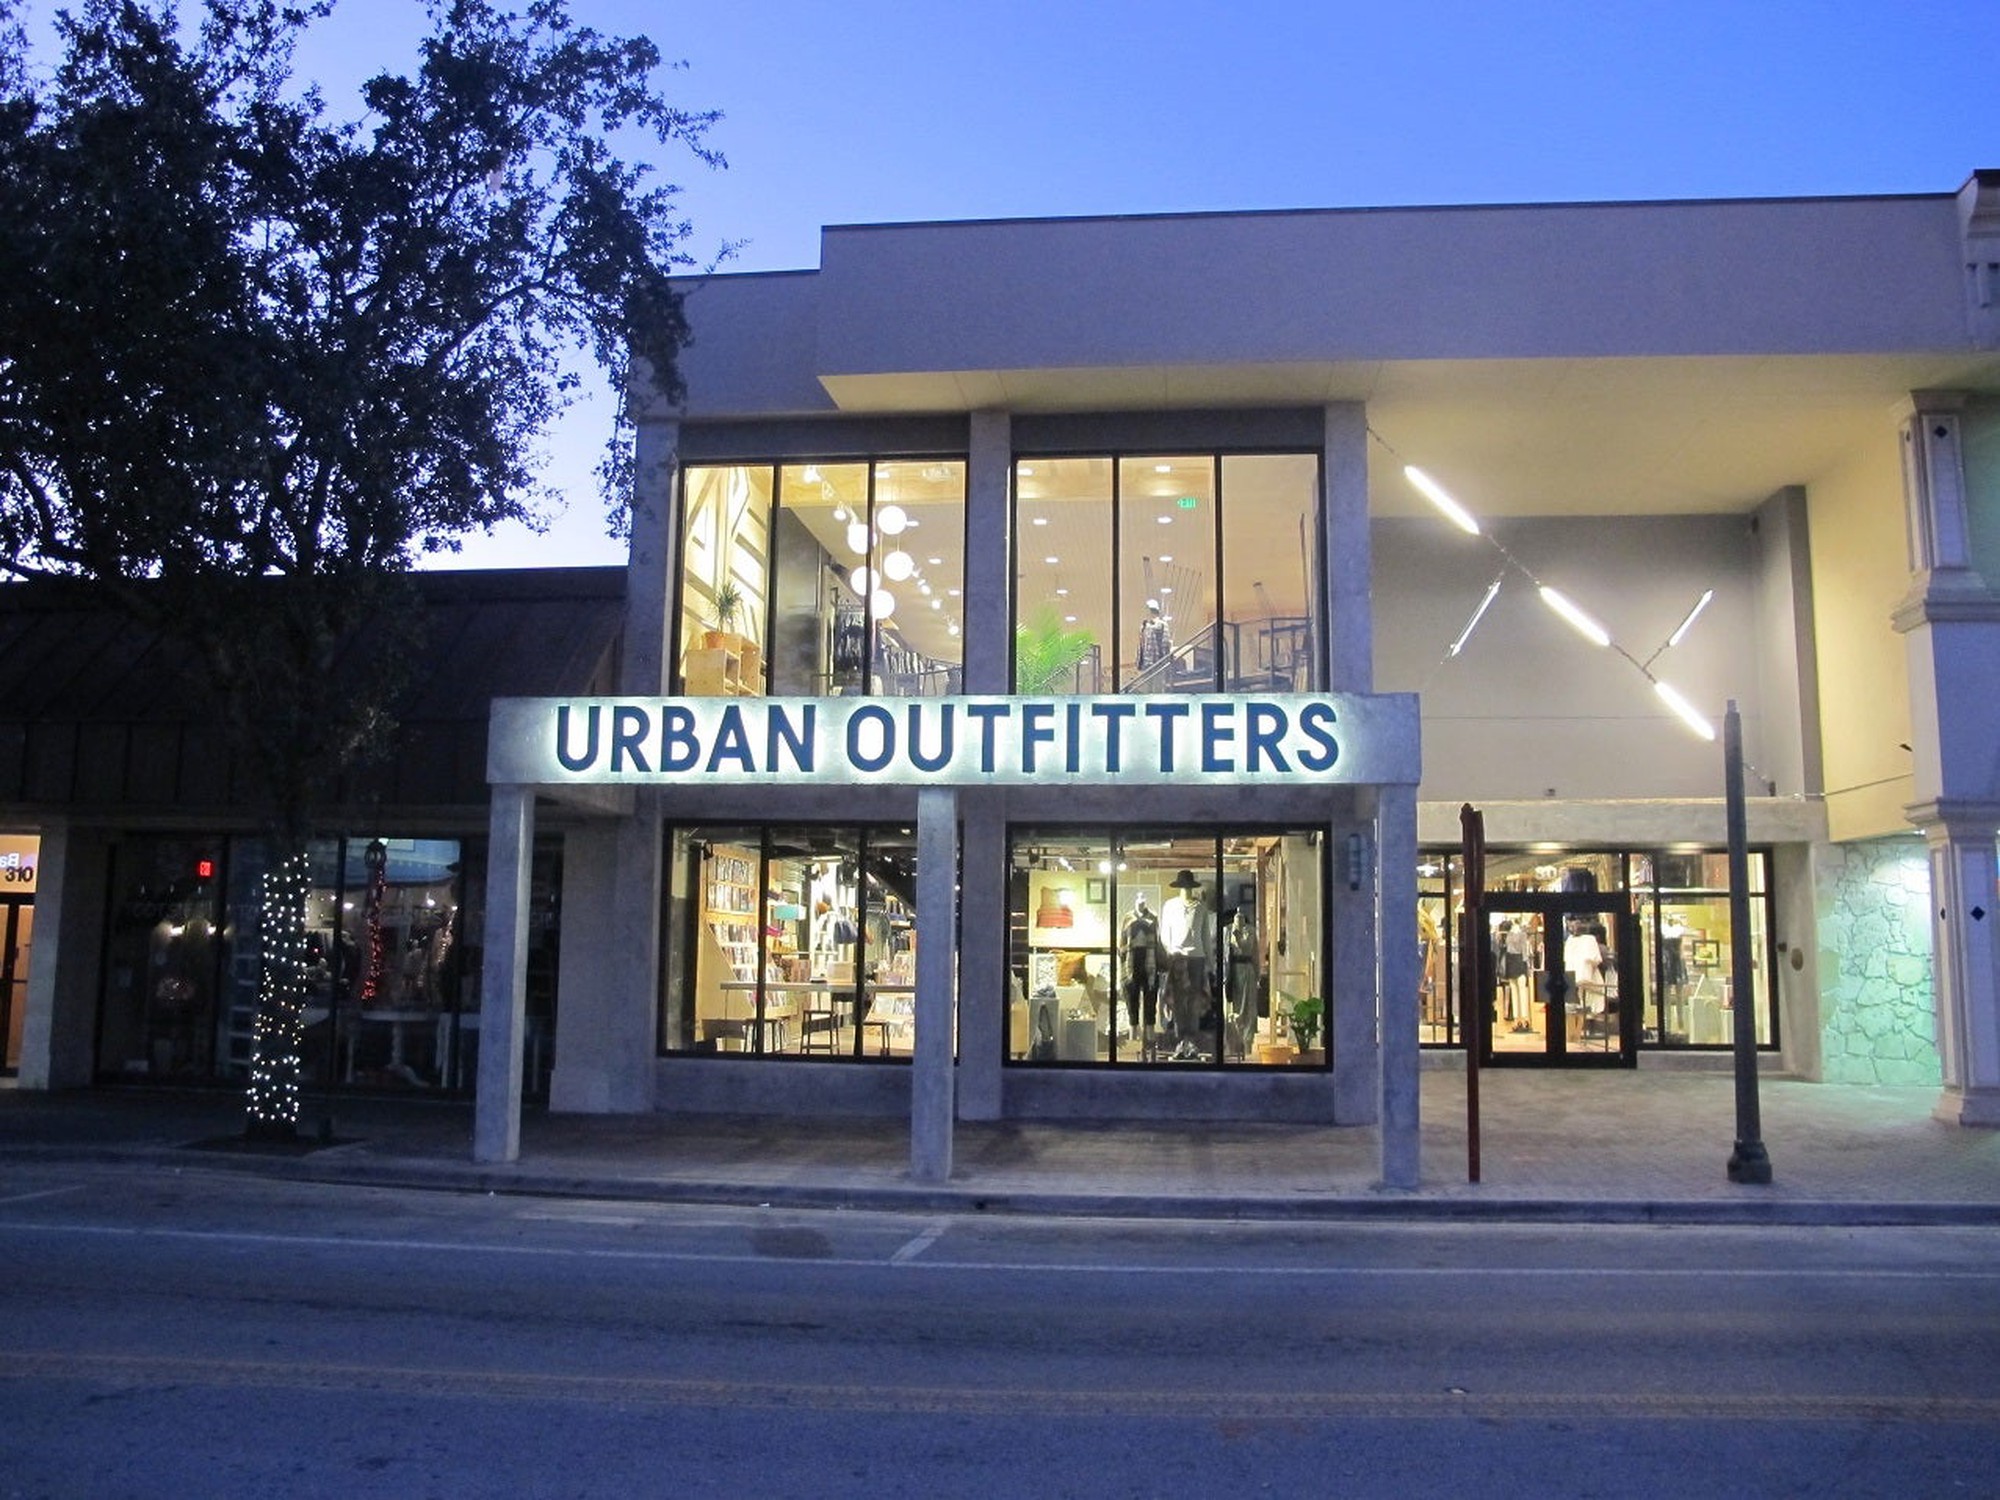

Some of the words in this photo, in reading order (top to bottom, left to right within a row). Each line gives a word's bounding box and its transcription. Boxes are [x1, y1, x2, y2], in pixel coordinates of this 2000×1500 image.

[557, 704, 816, 772] URBAN
[846, 702, 1339, 772] OUTFITTERS
[5, 866, 34, 882] 310
